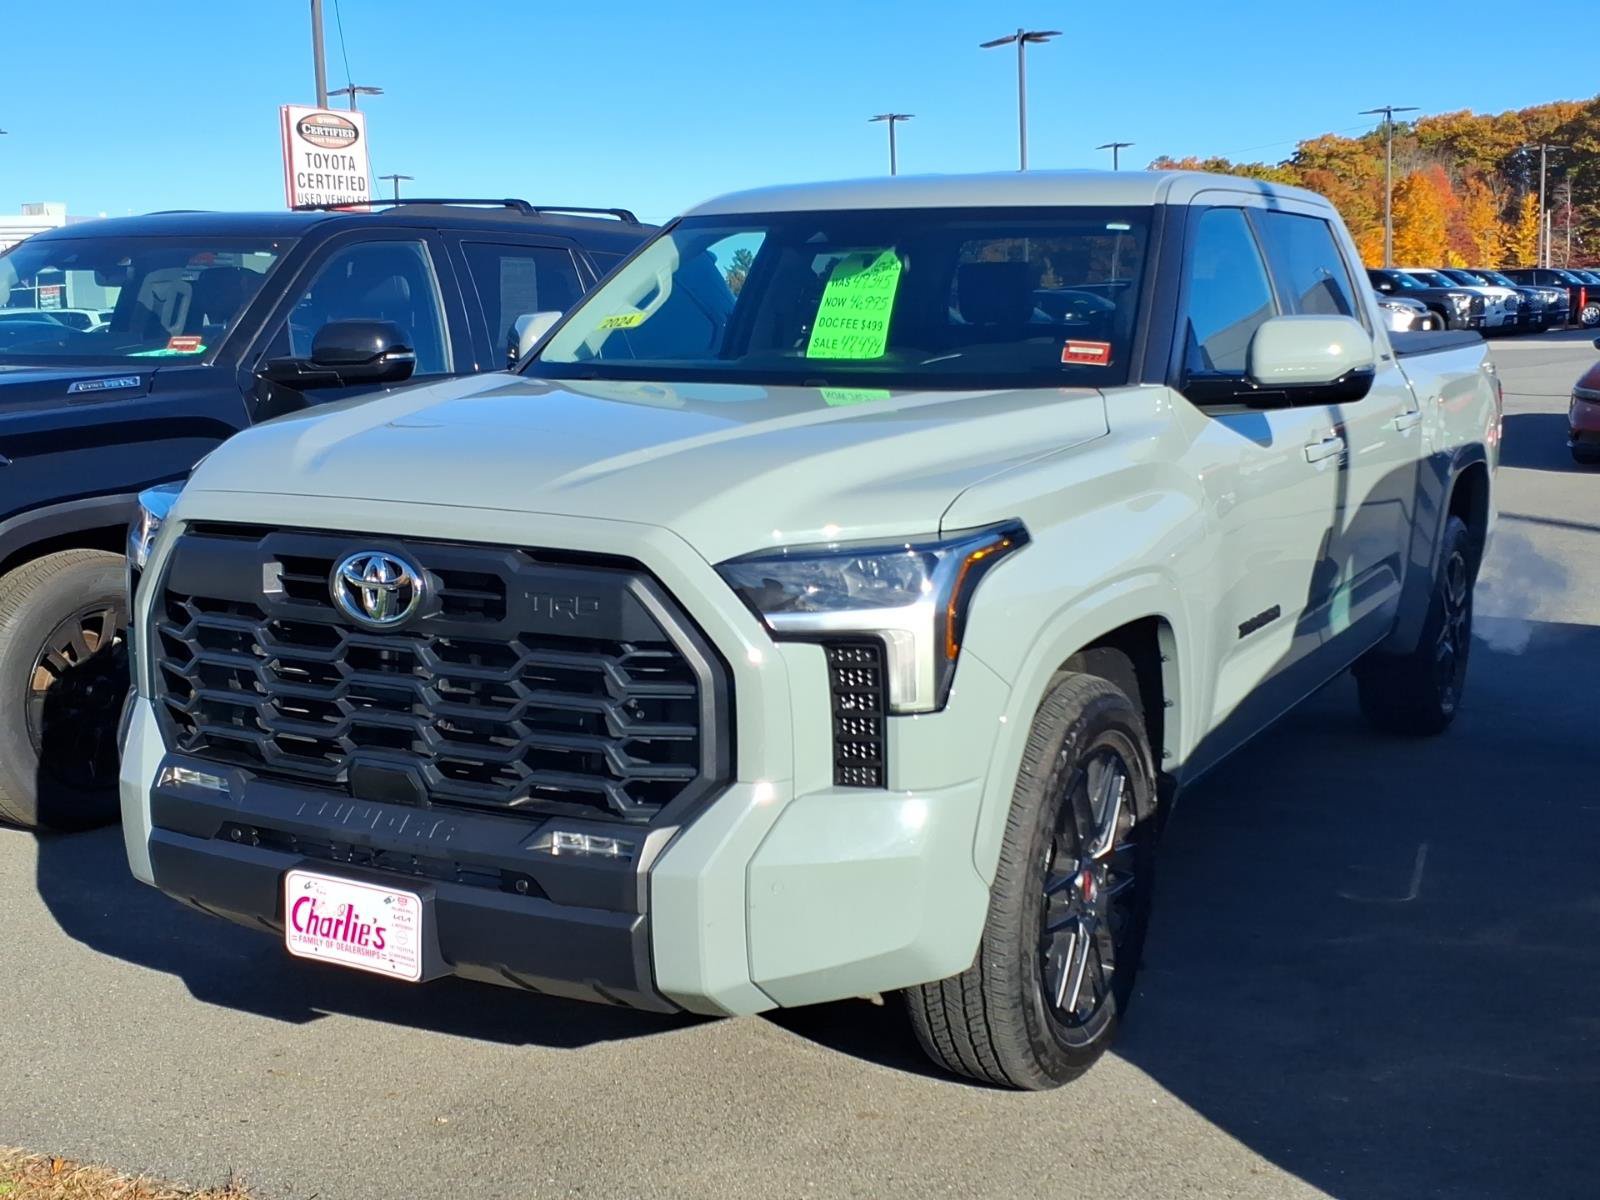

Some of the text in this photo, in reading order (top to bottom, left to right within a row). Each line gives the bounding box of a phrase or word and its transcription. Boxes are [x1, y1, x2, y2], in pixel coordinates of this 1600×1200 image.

[304, 152, 356, 171] TOYOTA
[297, 172, 365, 191] CERTIFIED
[298, 192, 321, 204] USED
[824, 297, 847, 308] NOW
[818, 317, 883, 331] DOC FEE $499
[813, 337, 838, 350] SALE
[291, 895, 387, 950] Charlie's
[298, 935, 324, 948] FAMILY
[326, 940, 334, 948] OF
[336, 941, 381, 960] DEALERSHIPS
